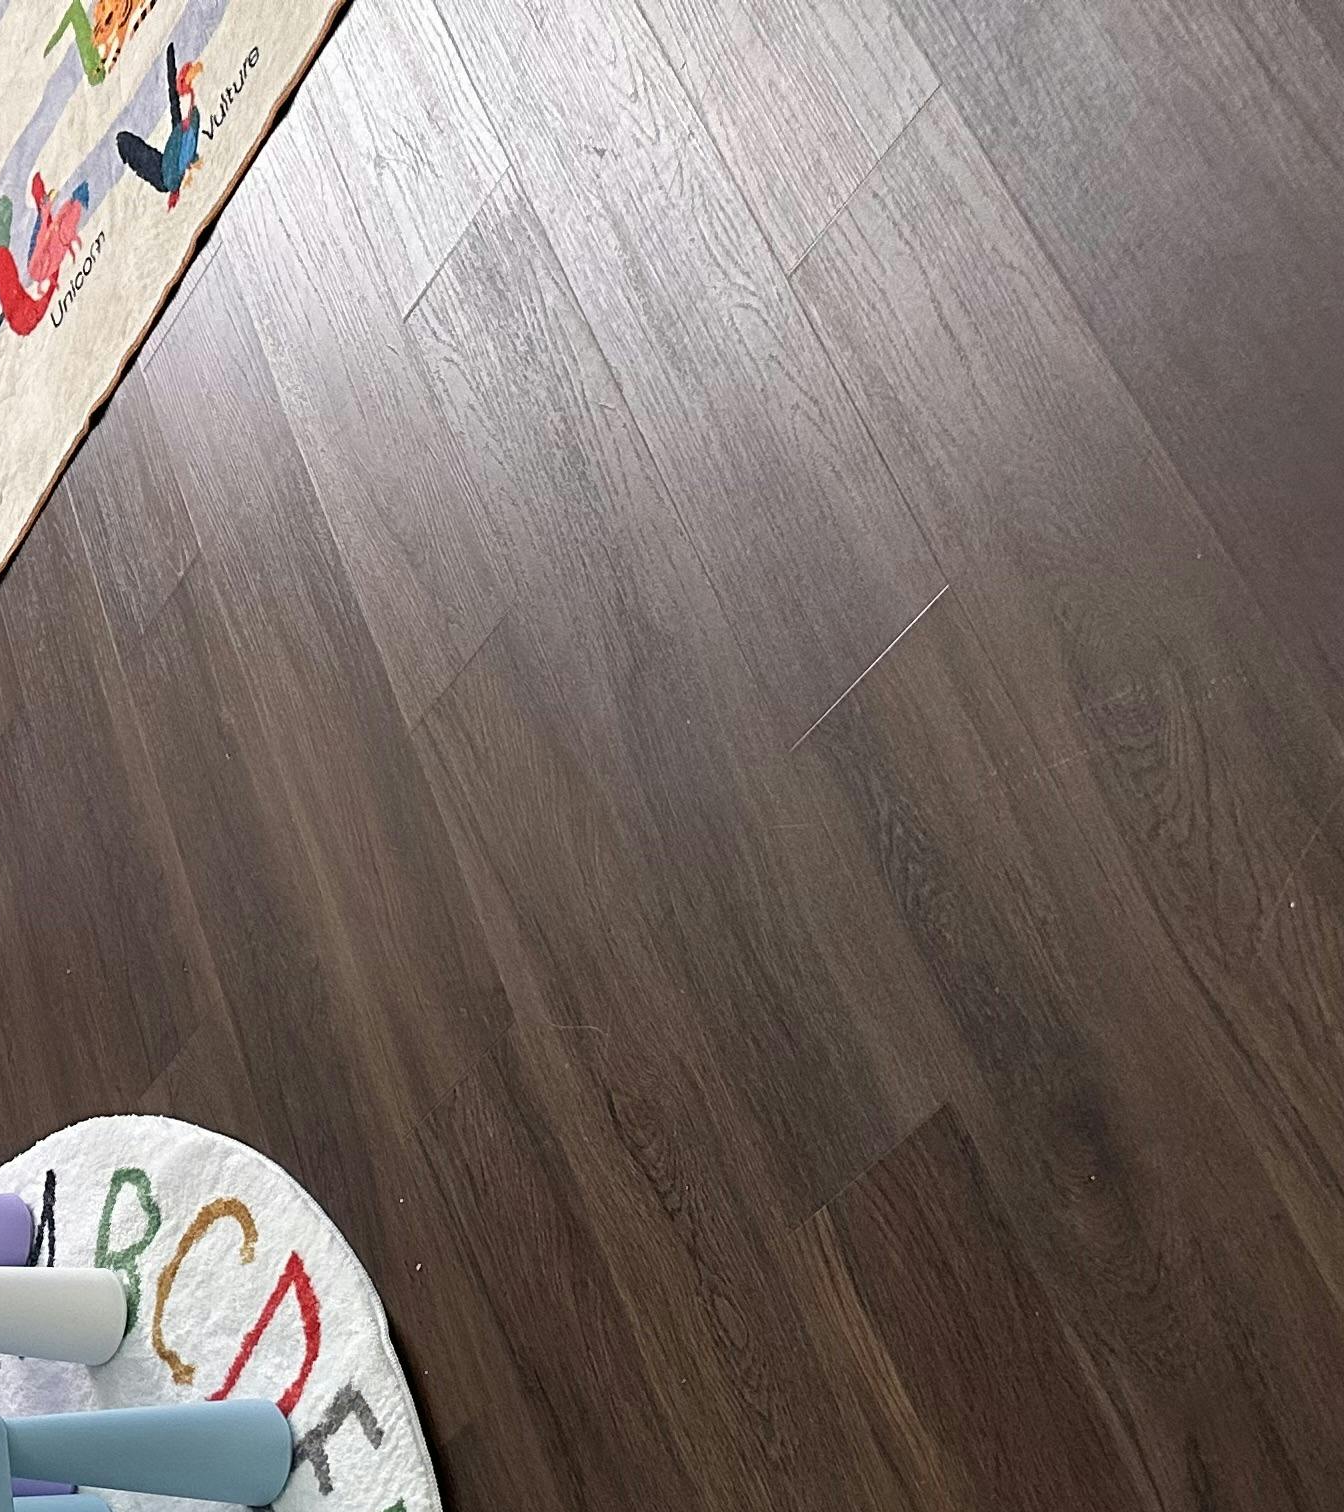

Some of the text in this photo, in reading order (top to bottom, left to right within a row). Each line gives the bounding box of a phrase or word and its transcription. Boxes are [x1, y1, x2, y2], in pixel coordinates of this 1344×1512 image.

[200, 45, 261, 140] Vulture
[50, 231, 105, 328] Unicorn
[152, 1198, 259, 1386] C
